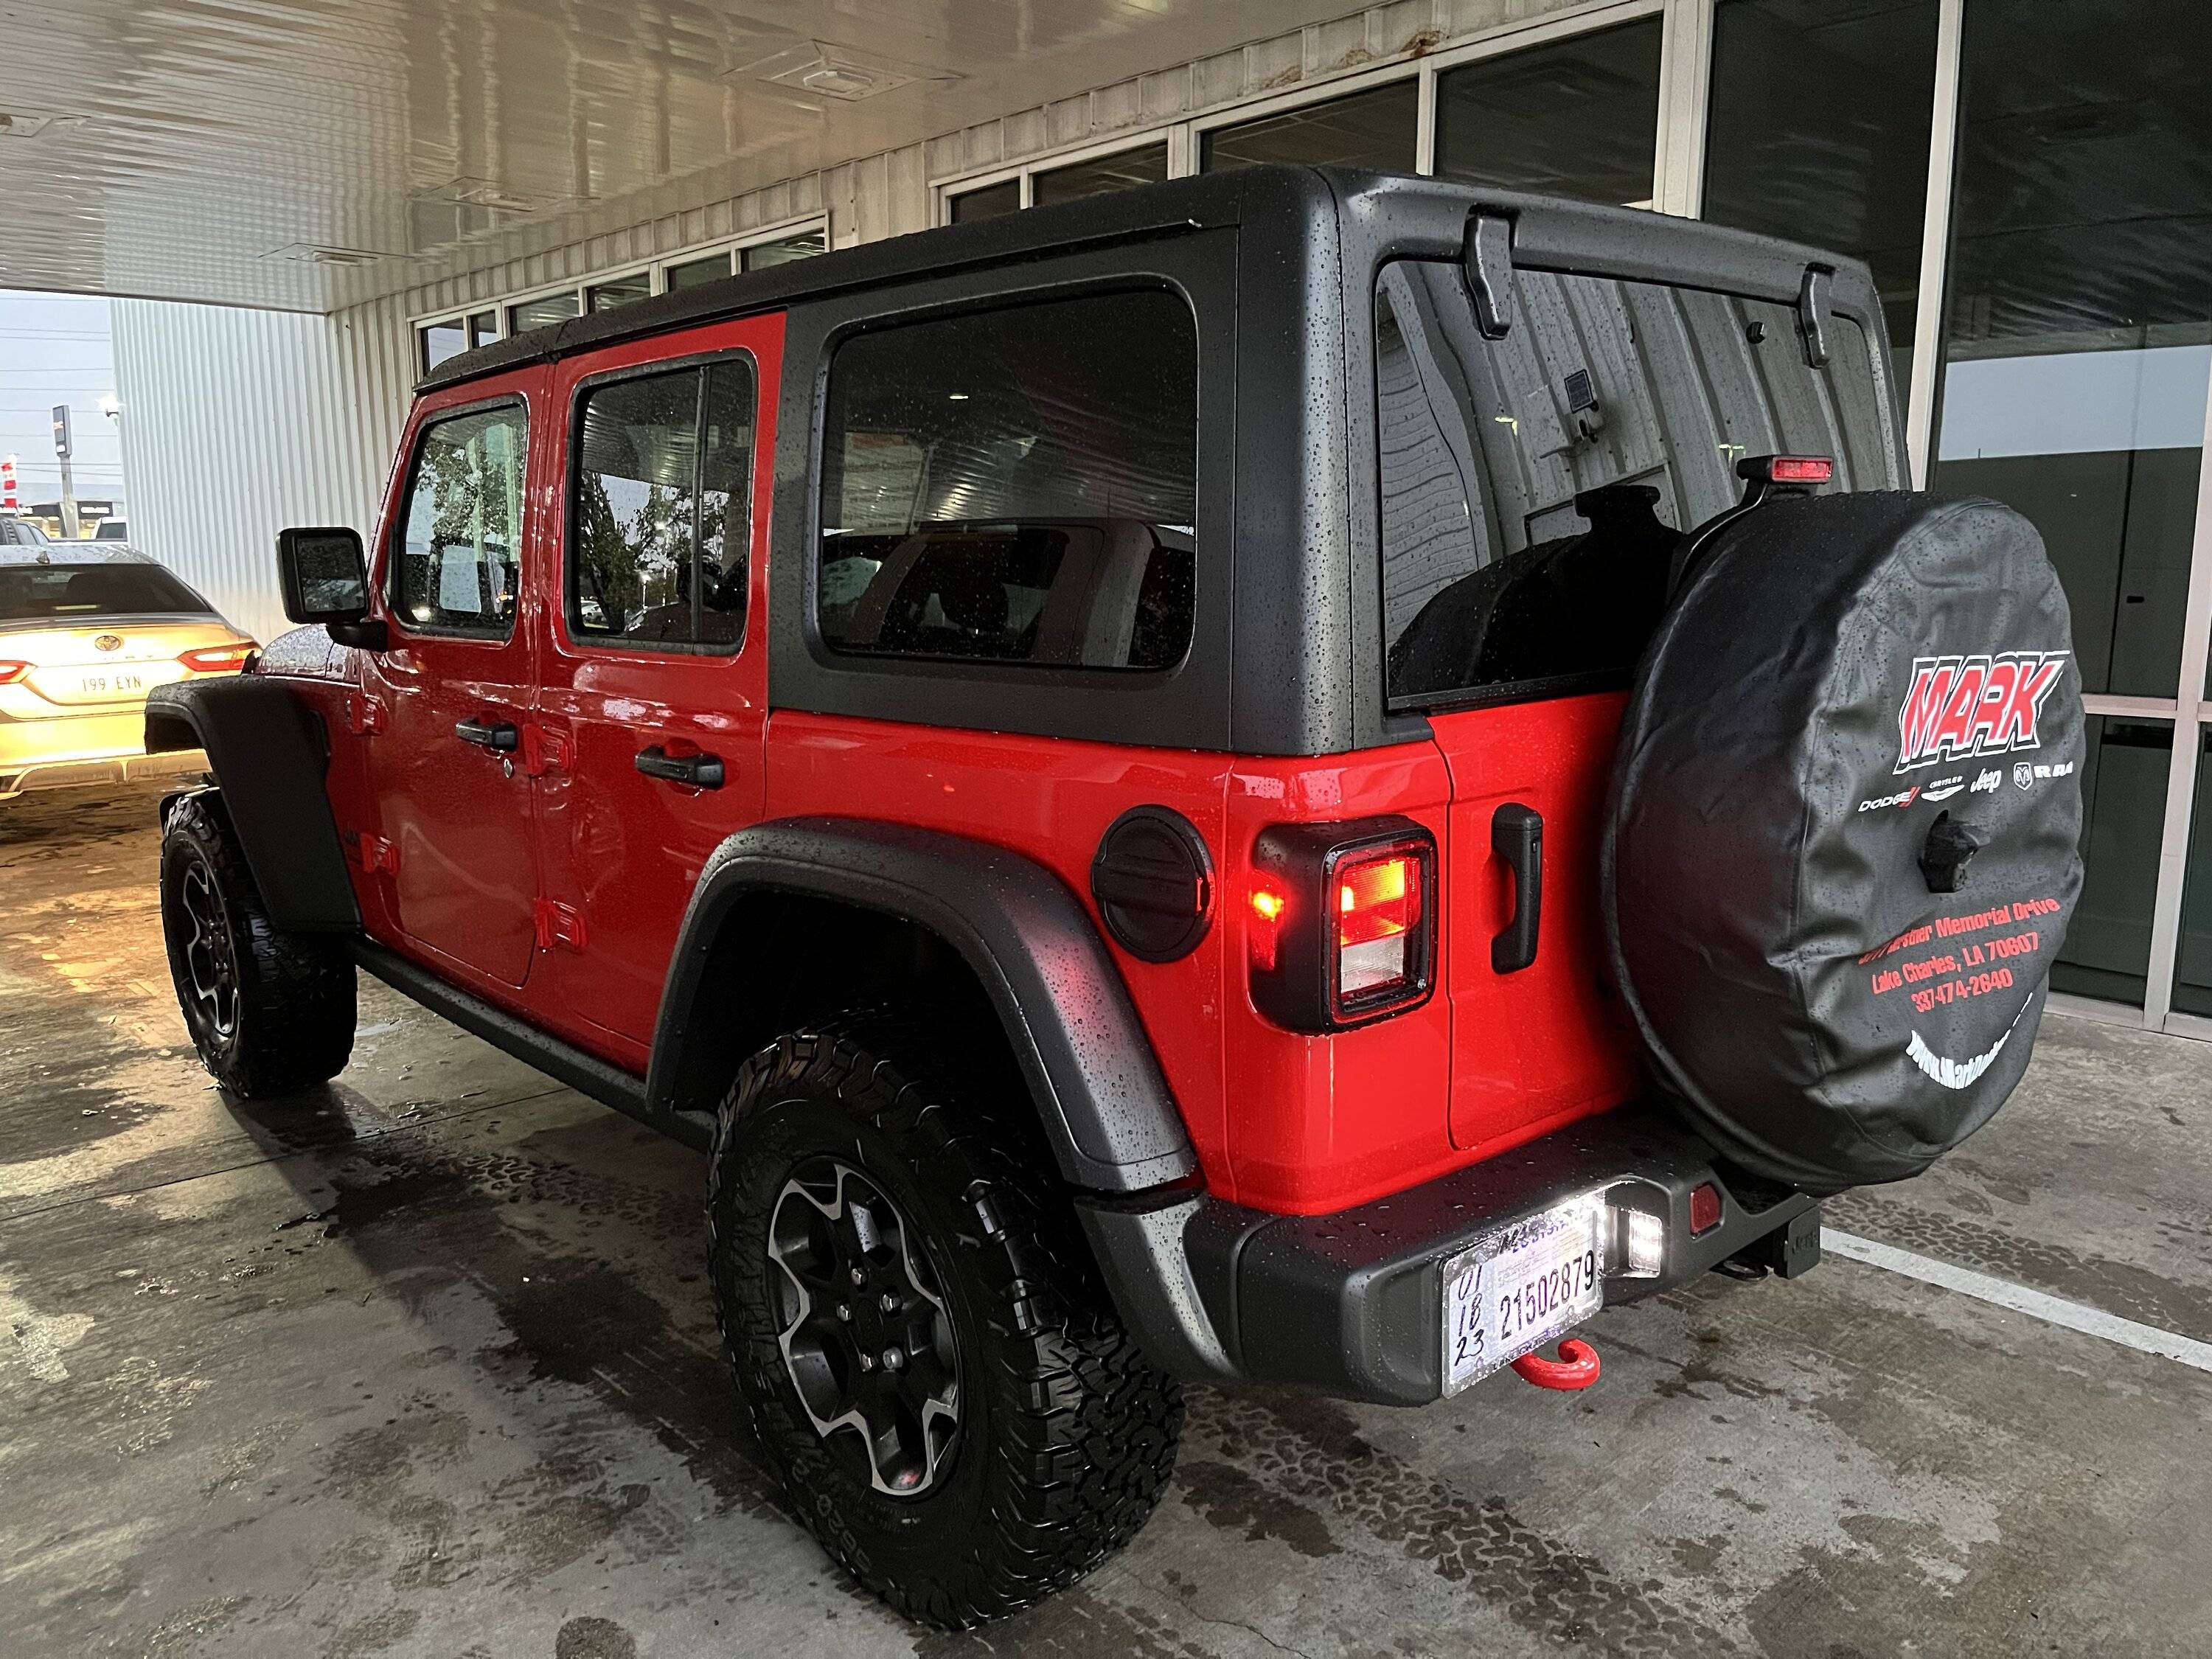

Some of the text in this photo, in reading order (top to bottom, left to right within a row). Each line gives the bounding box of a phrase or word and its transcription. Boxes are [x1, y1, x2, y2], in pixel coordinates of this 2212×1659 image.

[83, 675, 141, 692] 199 EYN
[1893, 650, 2070, 775] MARK
[1970, 768, 2002, 793] Jeep
[1858, 790, 1913, 812] DODGE
[1935, 905, 2011, 938] Memorial
[2013, 898, 2060, 921] Drive
[1871, 931, 2039, 995] Lake Charles, LA 70607
[1500, 1249, 1594, 1340] 21502879
[1458, 1293, 1483, 1337] 18
[1454, 1329, 1484, 1366] 23
